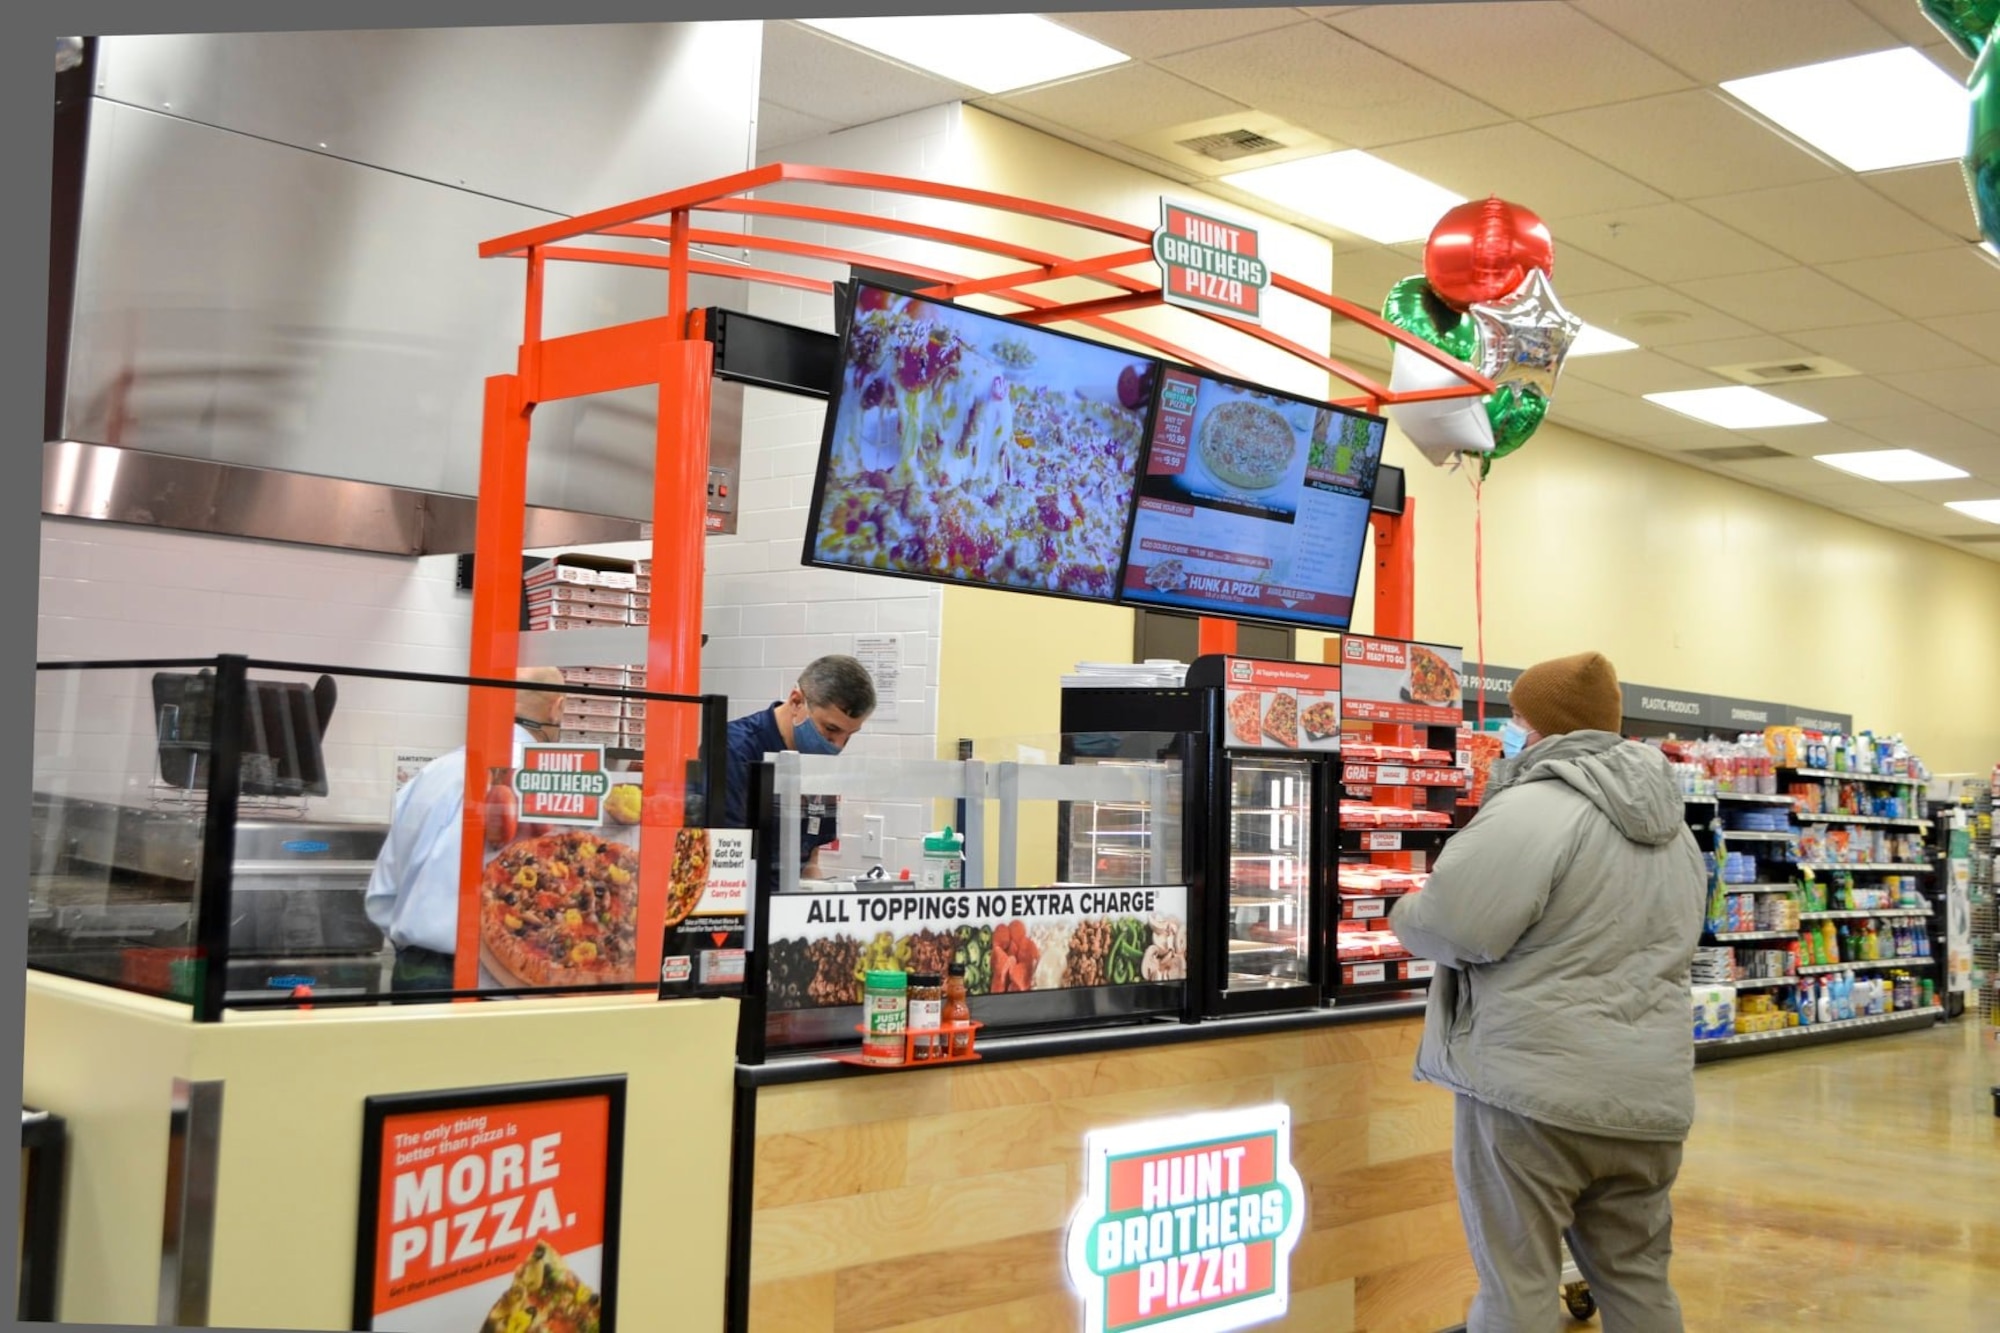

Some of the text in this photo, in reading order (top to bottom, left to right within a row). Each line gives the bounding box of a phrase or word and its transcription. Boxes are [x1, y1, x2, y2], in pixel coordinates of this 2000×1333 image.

[1185, 217, 1240, 254] HUNT
[1163, 236, 1261, 286] BROTHERS
[1185, 266, 1242, 305] PIZZA
[1189, 576, 1261, 598] HUNK A PIZZA
[1266, 586, 1316, 600] AVAILABLE BELOW
[1366, 642, 1380, 651] HOT.
[1381, 643, 1400, 654] FRESH.
[1366, 652, 1405, 664] READY TO GO.
[1641, 697, 1699, 715] PLASTIC PRODUCTS
[538, 753, 584, 772] HUNT
[520, 772, 603, 793] BROTHERS
[1434, 771, 1440, 782] 2
[536, 792, 584, 813] PIZZA
[715, 849, 742, 858] Got Our
[718, 839, 741, 848] You've
[712, 859, 744, 868] Number!
[707, 879, 747, 888] Call Ahead &
[711, 889, 741, 899] Carry Out
[806, 891, 1155, 924] ALL TOPPINGS NO EXTRA CHARGE
[874, 1013, 900, 1025] JUST
[394, 1116, 487, 1149] The only thing
[396, 1123, 517, 1166] better than pizza is
[392, 1131, 562, 1225] MORE
[1142, 1146, 1245, 1213] HUNT
[389, 1187, 577, 1283] PIZZA.
[1097, 1189, 1283, 1271] BROTHERS
[389, 1287, 406, 1297] Get
[406, 1280, 427, 1292] that
[427, 1269, 458, 1285] second
[460, 1262, 483, 1275] Hunk
[485, 1259, 492, 1268] A
[1138, 1242, 1247, 1316] PIZZA
